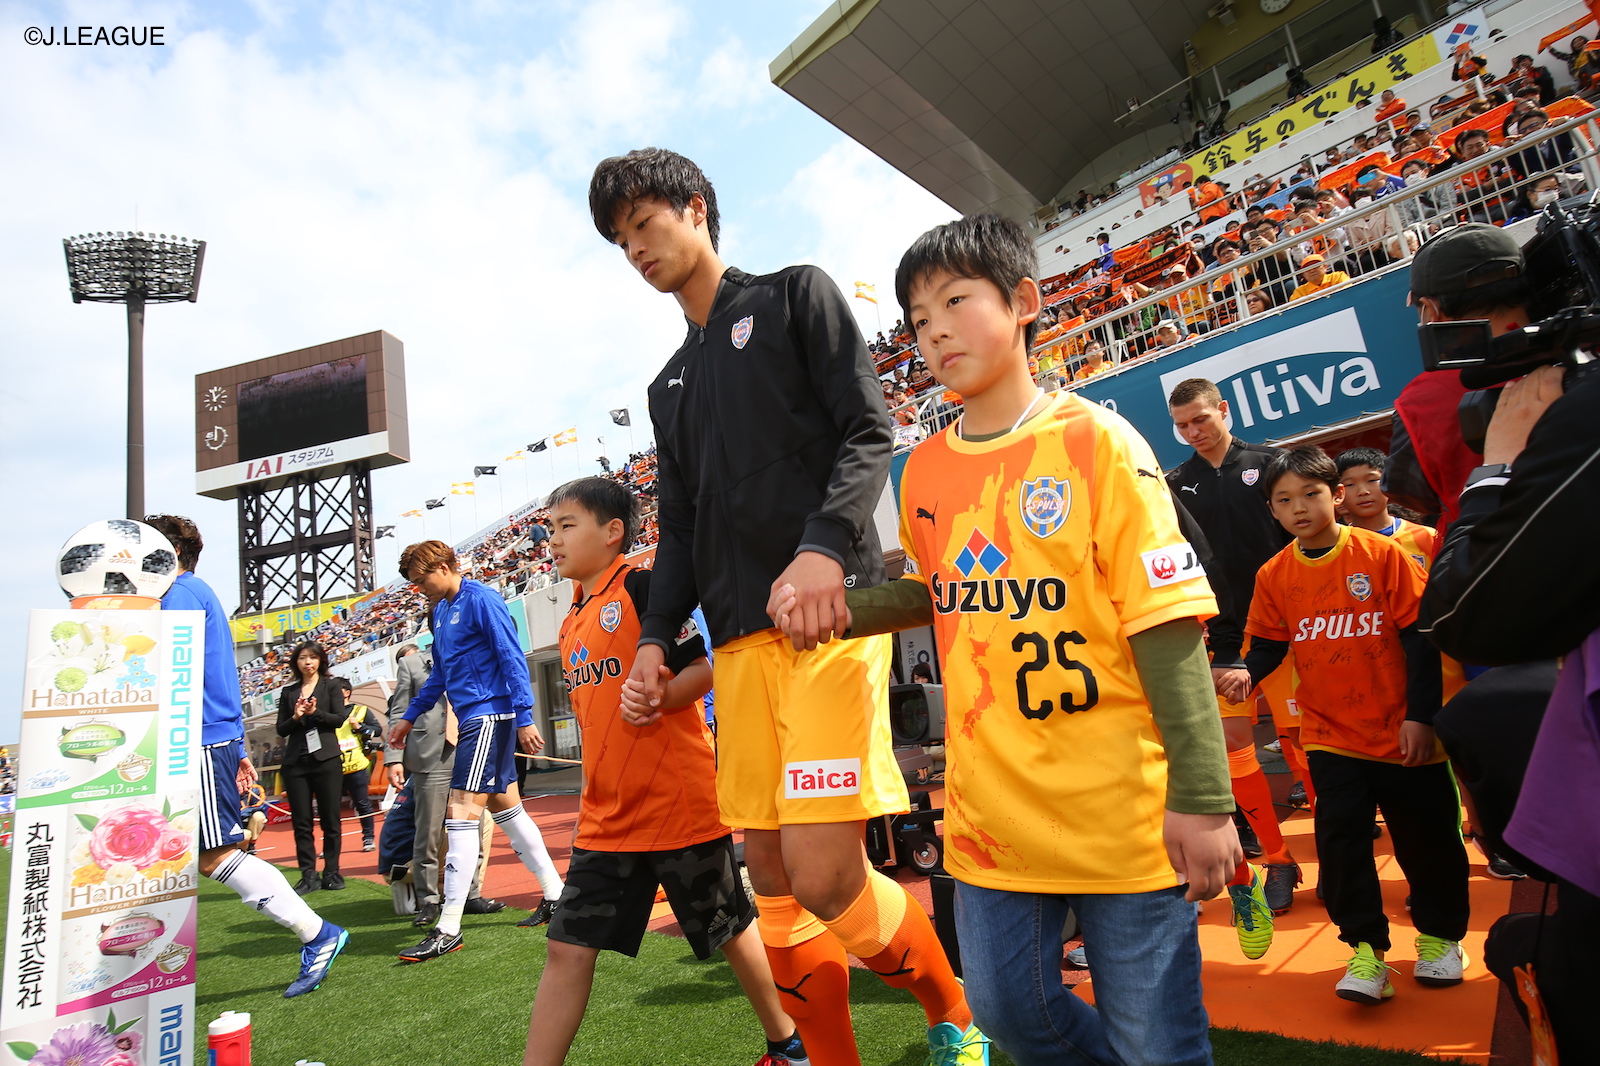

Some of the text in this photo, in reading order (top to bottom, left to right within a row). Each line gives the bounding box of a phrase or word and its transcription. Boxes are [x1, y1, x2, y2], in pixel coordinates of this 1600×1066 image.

[1202, 53, 1408, 174] 鈴与のでんき
[246, 447, 334, 480] IAI スタジアム
[515, 502, 537, 519] yazaki
[1315, 606, 1355, 615] SHIMIZU
[1294, 611, 1384, 642] S-PULSE
[1011, 630, 1099, 720] 25
[31, 684, 153, 708] Hanataba
[78, 707, 110, 715] WHITE
[788, 767, 857, 790] Taica
[70, 870, 192, 907] Hanataba
[16, 822, 54, 1010] 丸富製紙株式会社
[90, 894, 173, 914] FLOWER PRINTED
